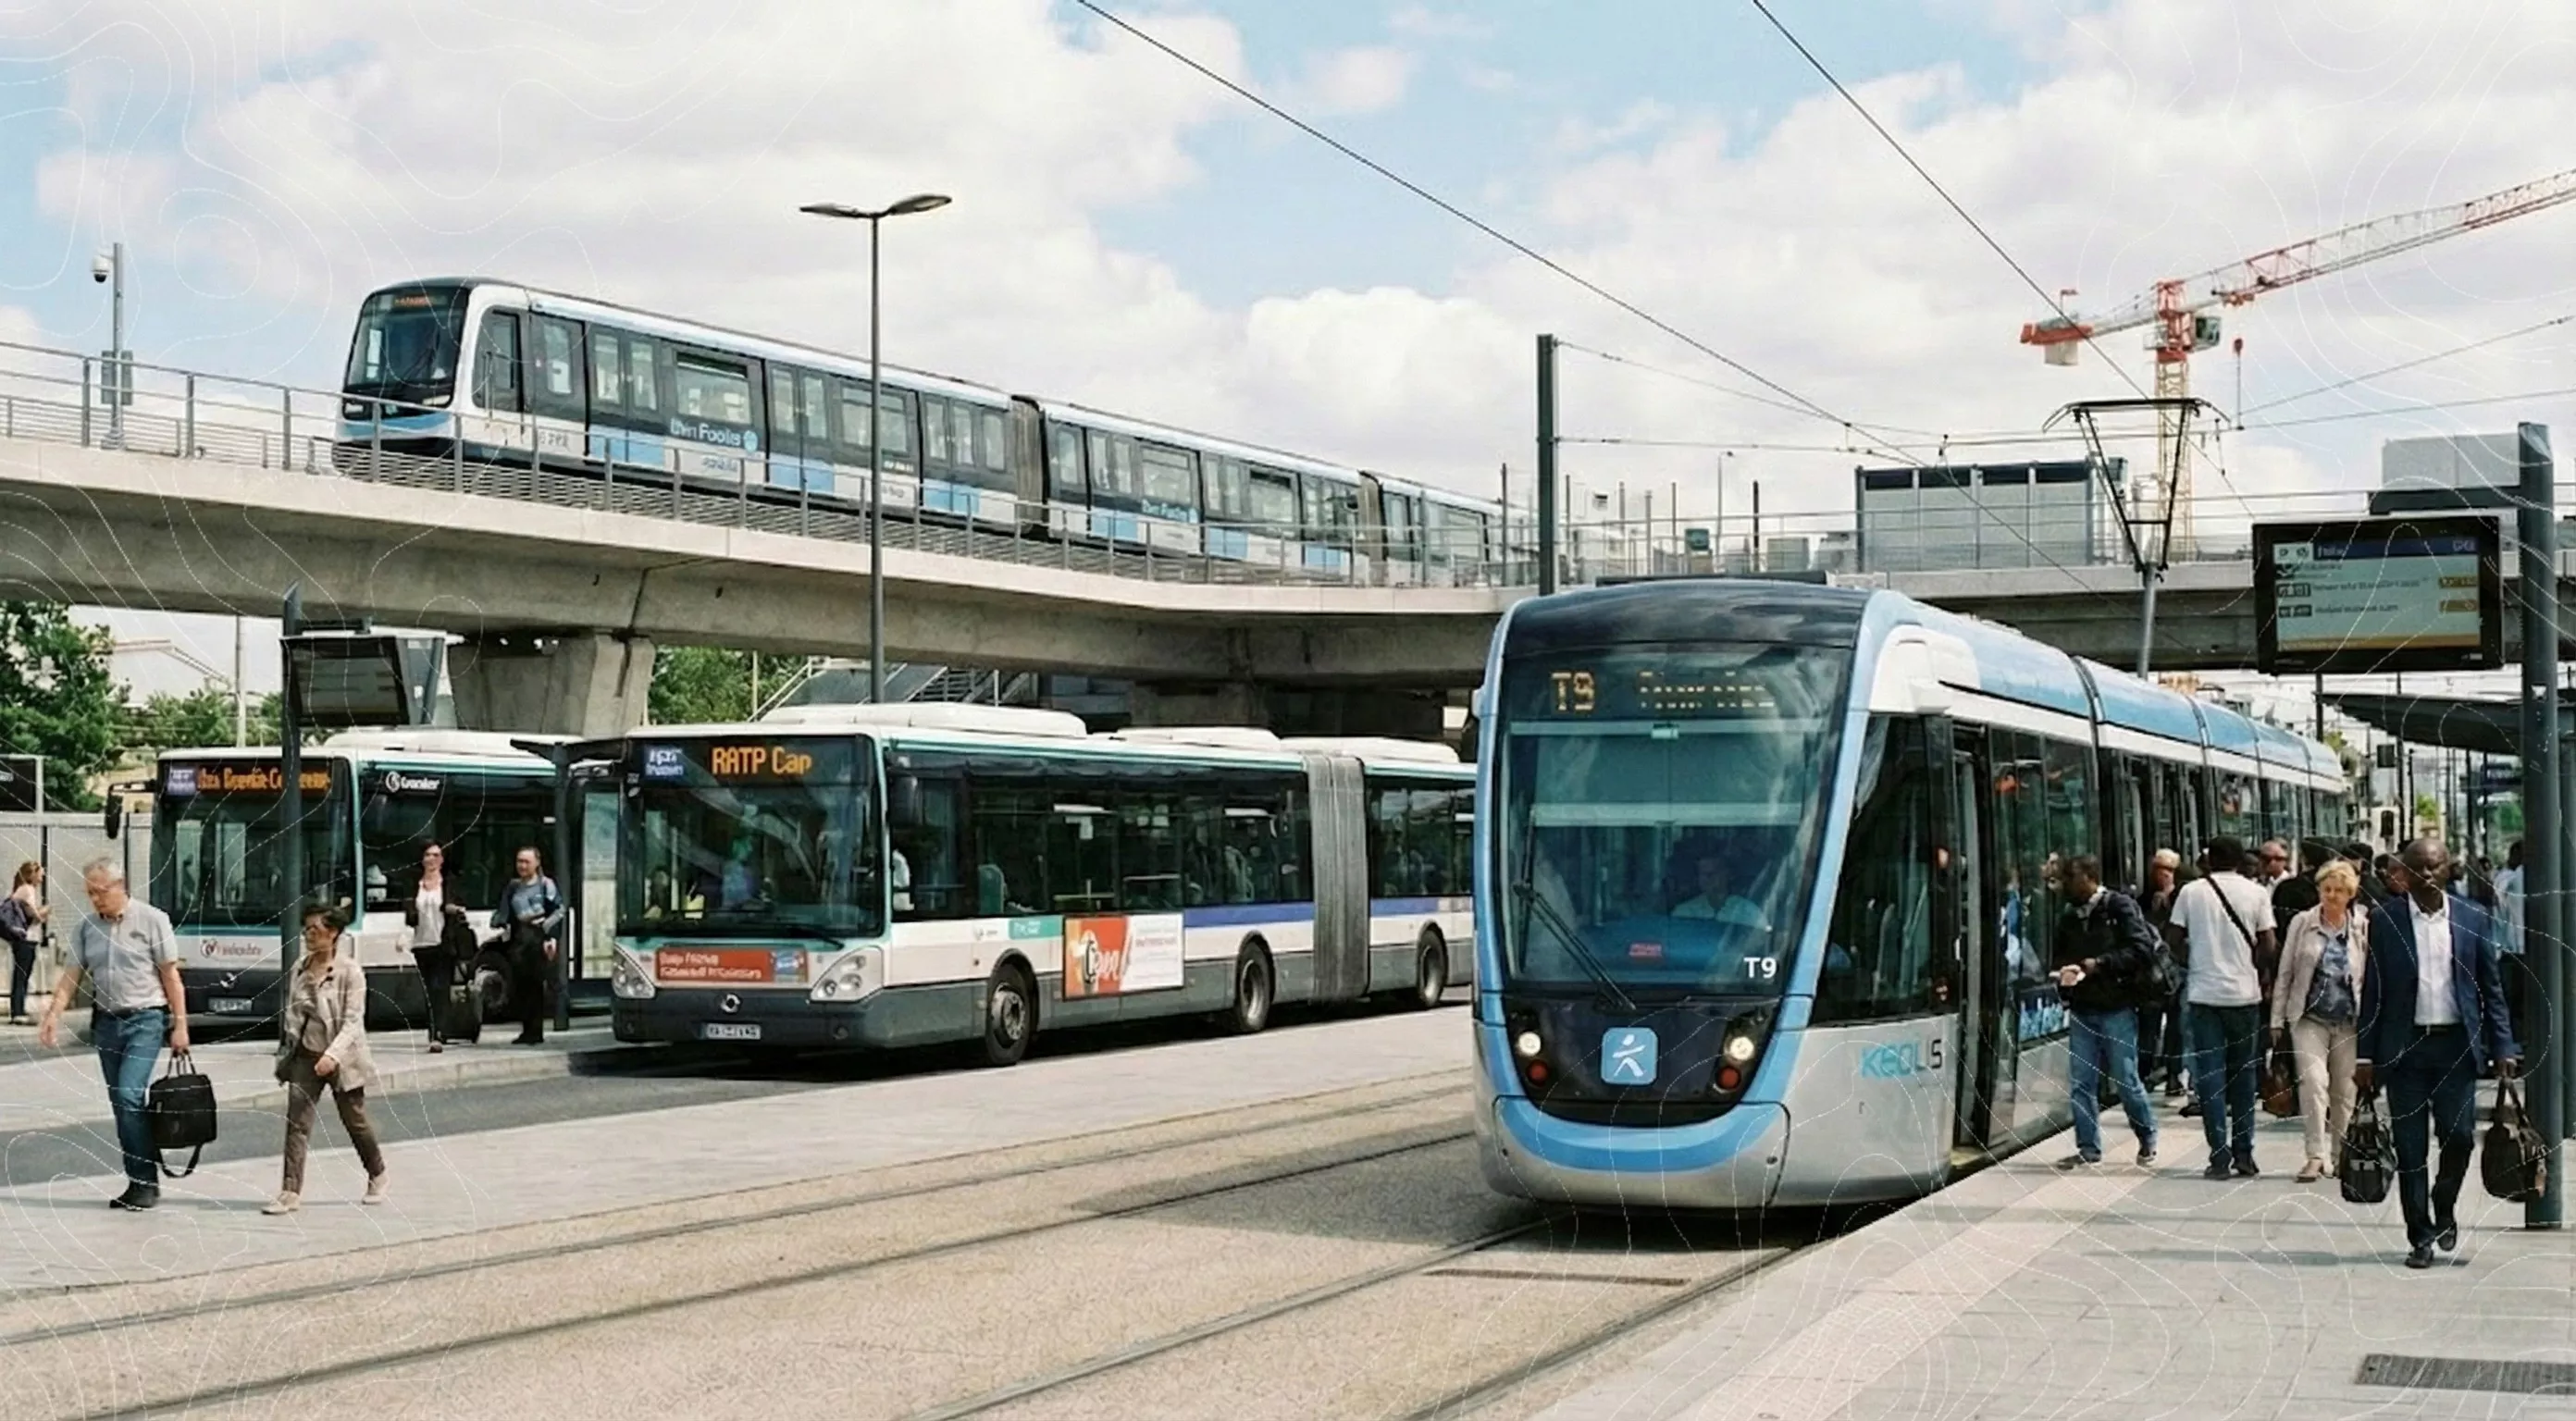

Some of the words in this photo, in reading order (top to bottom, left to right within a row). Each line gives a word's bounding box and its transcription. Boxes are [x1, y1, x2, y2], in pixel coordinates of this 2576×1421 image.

[1552, 672, 1594, 710] T9
[712, 747, 766, 774] RATP
[772, 746, 812, 774] Cap
[1743, 957, 1777, 979] T9
